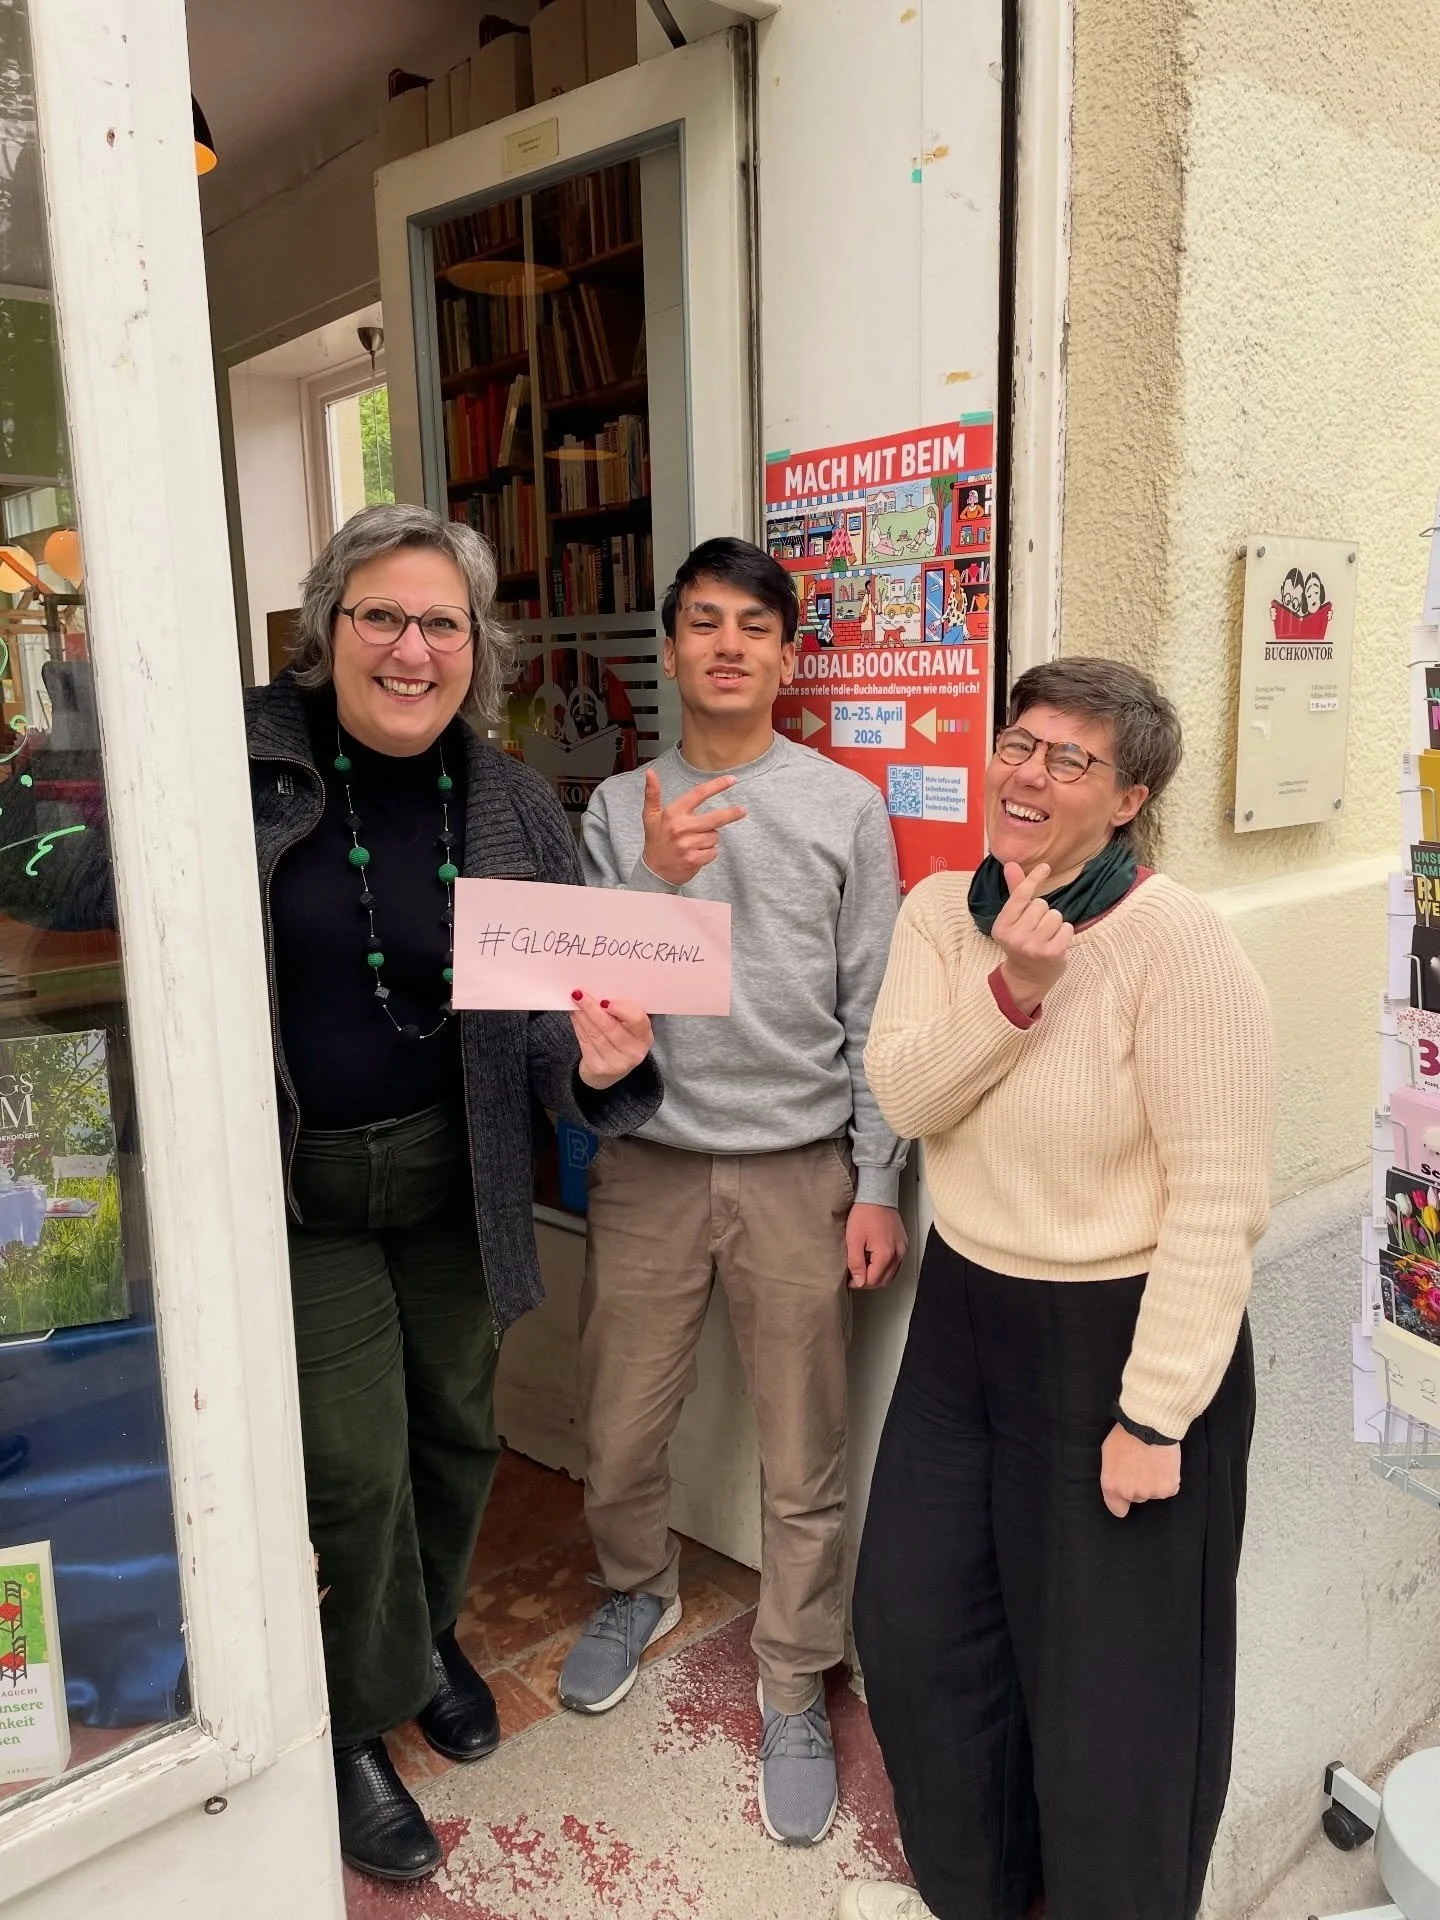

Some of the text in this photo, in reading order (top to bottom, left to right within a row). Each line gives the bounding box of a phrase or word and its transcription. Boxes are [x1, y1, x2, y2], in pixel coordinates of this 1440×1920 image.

[785, 433, 966, 497] MACH MIT BEIM
[1264, 646, 1334, 661] BUCHKONTOR
[800, 687, 809, 696] so
[810, 684, 829, 696] viele
[831, 682, 922, 698] Indie-Buchhandlungen
[923, 682, 937, 694] wie
[939, 682, 980, 697] möglich!
[875, 706, 903, 725] April
[854, 729, 882, 744] 2026
[478, 922, 705, 964] #GLOBALBOOKCRAWL
